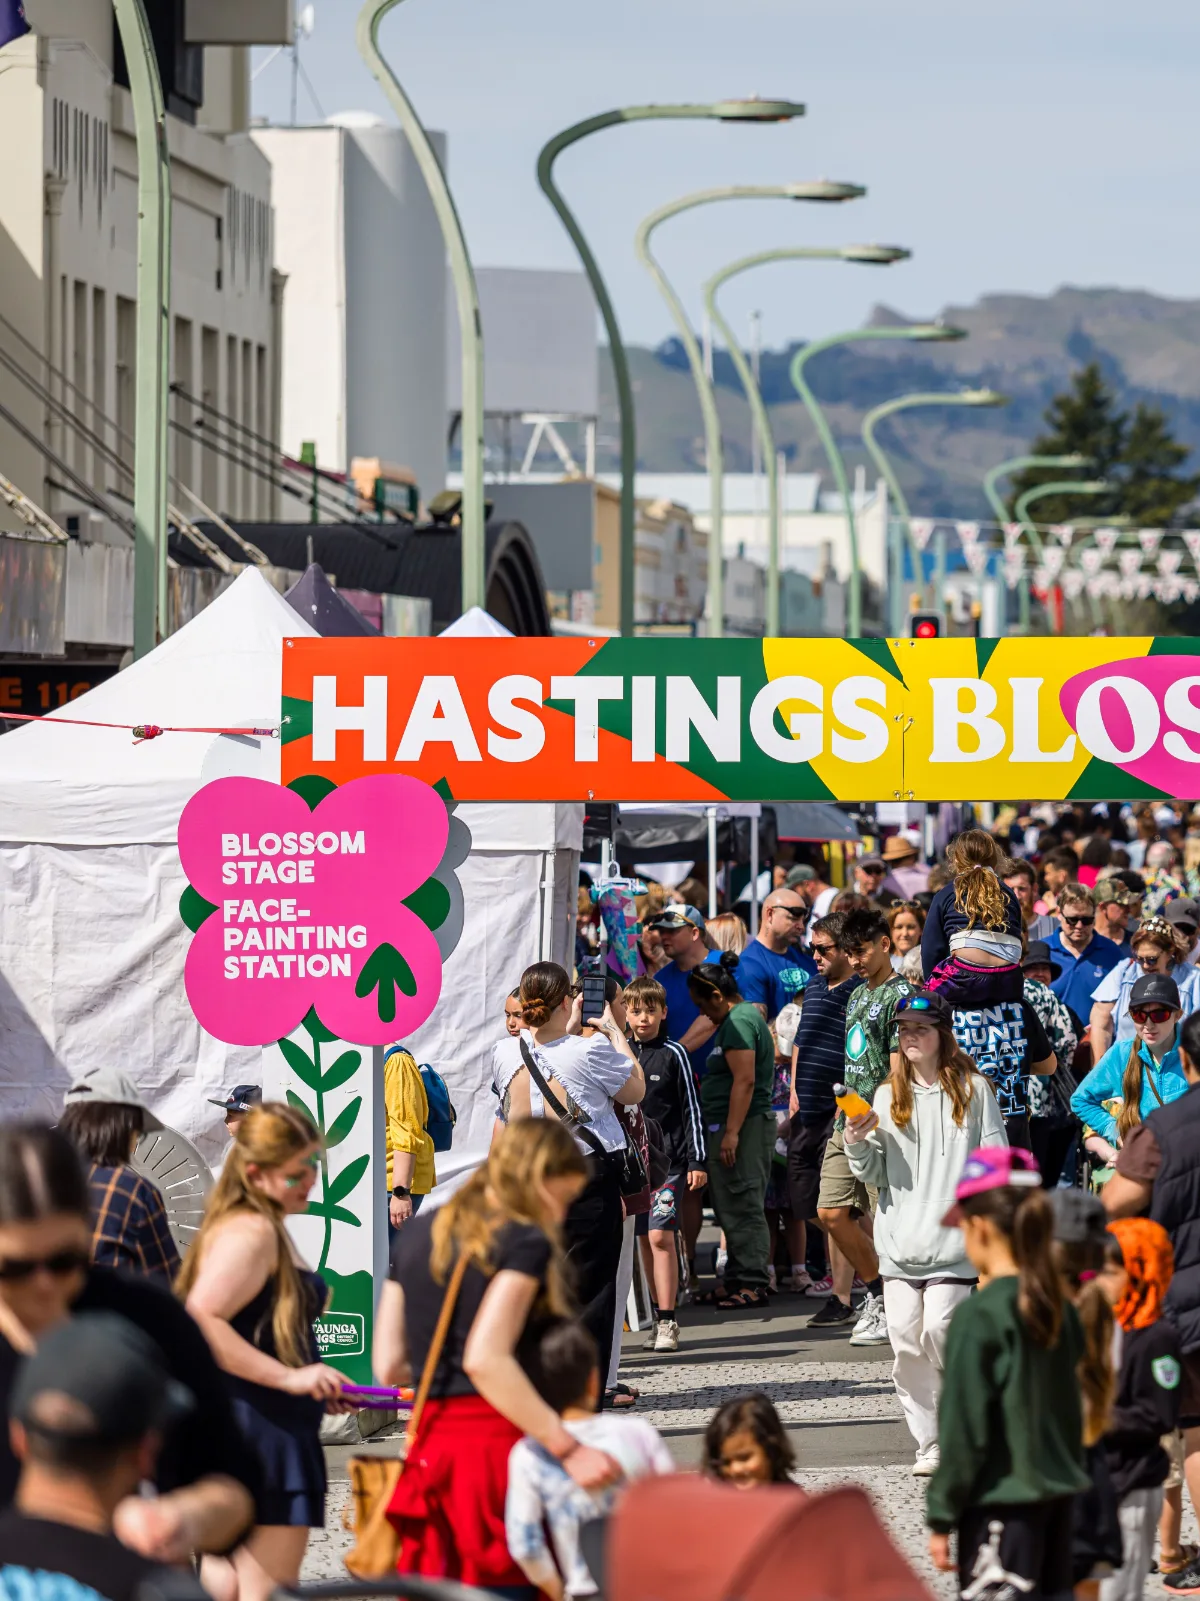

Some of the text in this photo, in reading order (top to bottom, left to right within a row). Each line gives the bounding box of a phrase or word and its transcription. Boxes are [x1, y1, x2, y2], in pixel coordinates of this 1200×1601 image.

[312, 674, 889, 764] HASTINGS
[221, 830, 366, 857] BLOSSOM
[222, 859, 315, 885] STAGE
[223, 898, 311, 923] FACE-
[223, 924, 367, 951] PAINTING
[224, 953, 352, 980] STATION
[952, 1021, 1024, 1046] HUNT
[977, 1056, 1019, 1077] OU
